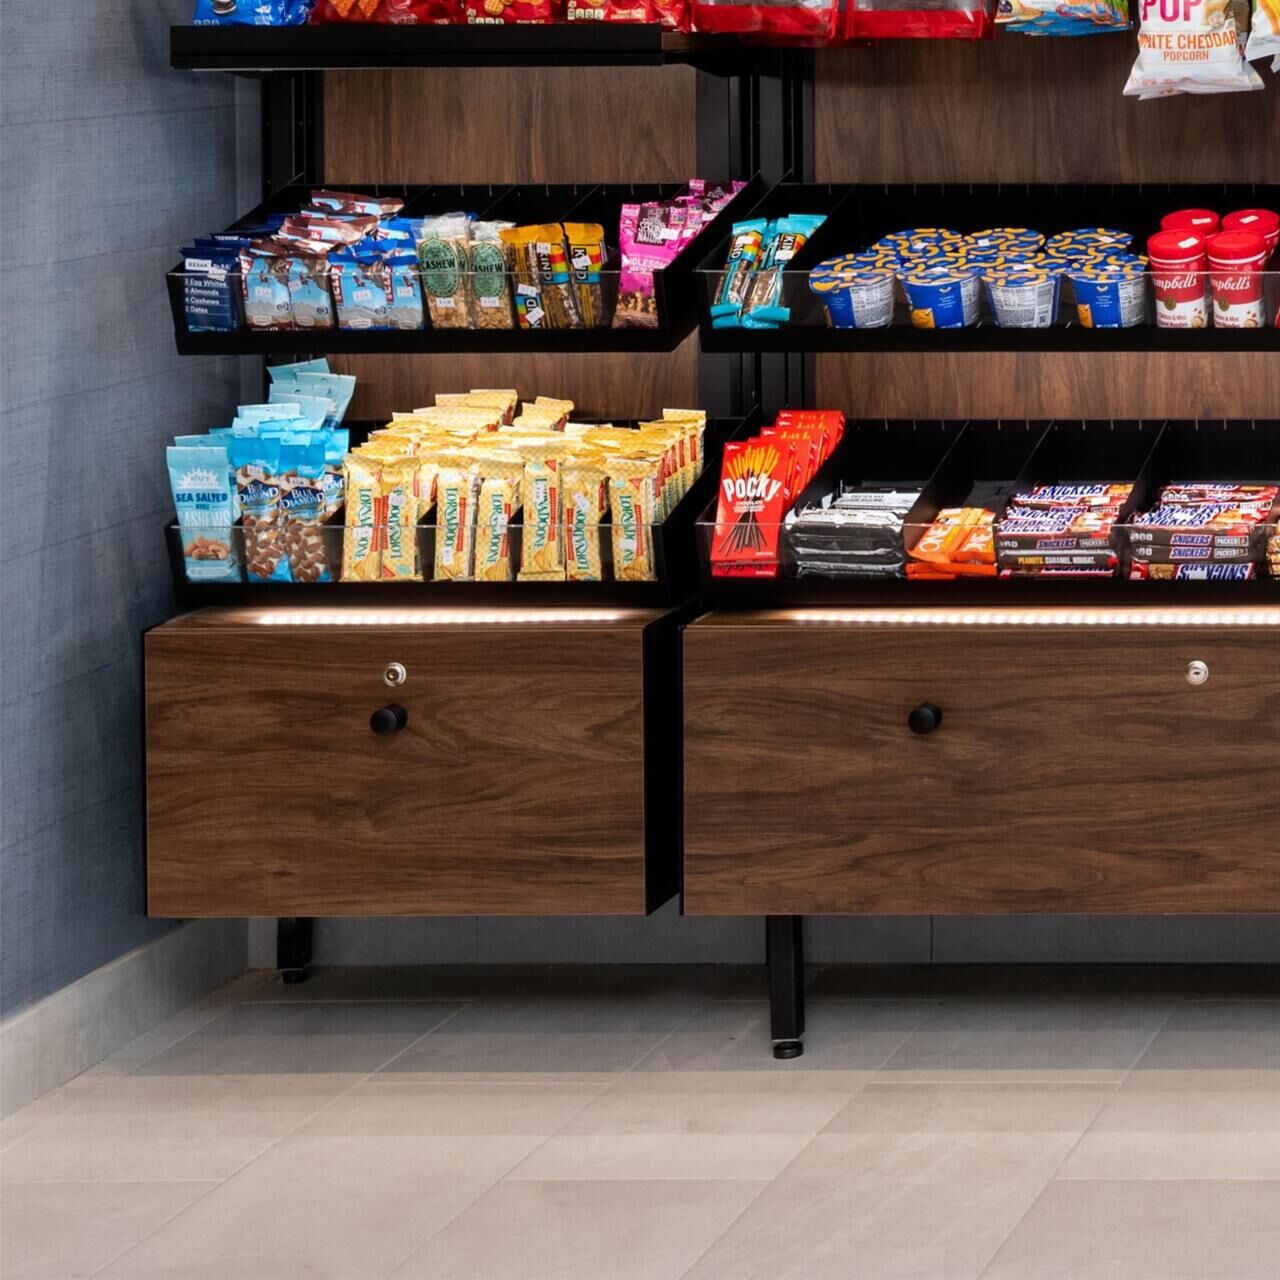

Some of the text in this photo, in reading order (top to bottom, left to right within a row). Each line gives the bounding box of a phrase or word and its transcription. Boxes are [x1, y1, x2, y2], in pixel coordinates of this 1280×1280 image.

[1138, 31, 1236, 50] WHITE CHEDDAR
[1163, 50, 1209, 61] POPCORN
[421, 261, 456, 270] CASHEW
[540, 252, 551, 281] KIND
[721, 473, 782, 501] POCKY
[176, 493, 227, 502] SEA SALTED
[238, 488, 279, 504] DIAMOND
[281, 493, 324, 509] DIAMOND
[919, 527, 951, 553] ONE
[1038, 540, 1075, 548] SNICKERS
[1171, 535, 1210, 545] SNICKERS
[1170, 548, 1210, 558] SNICKERS
